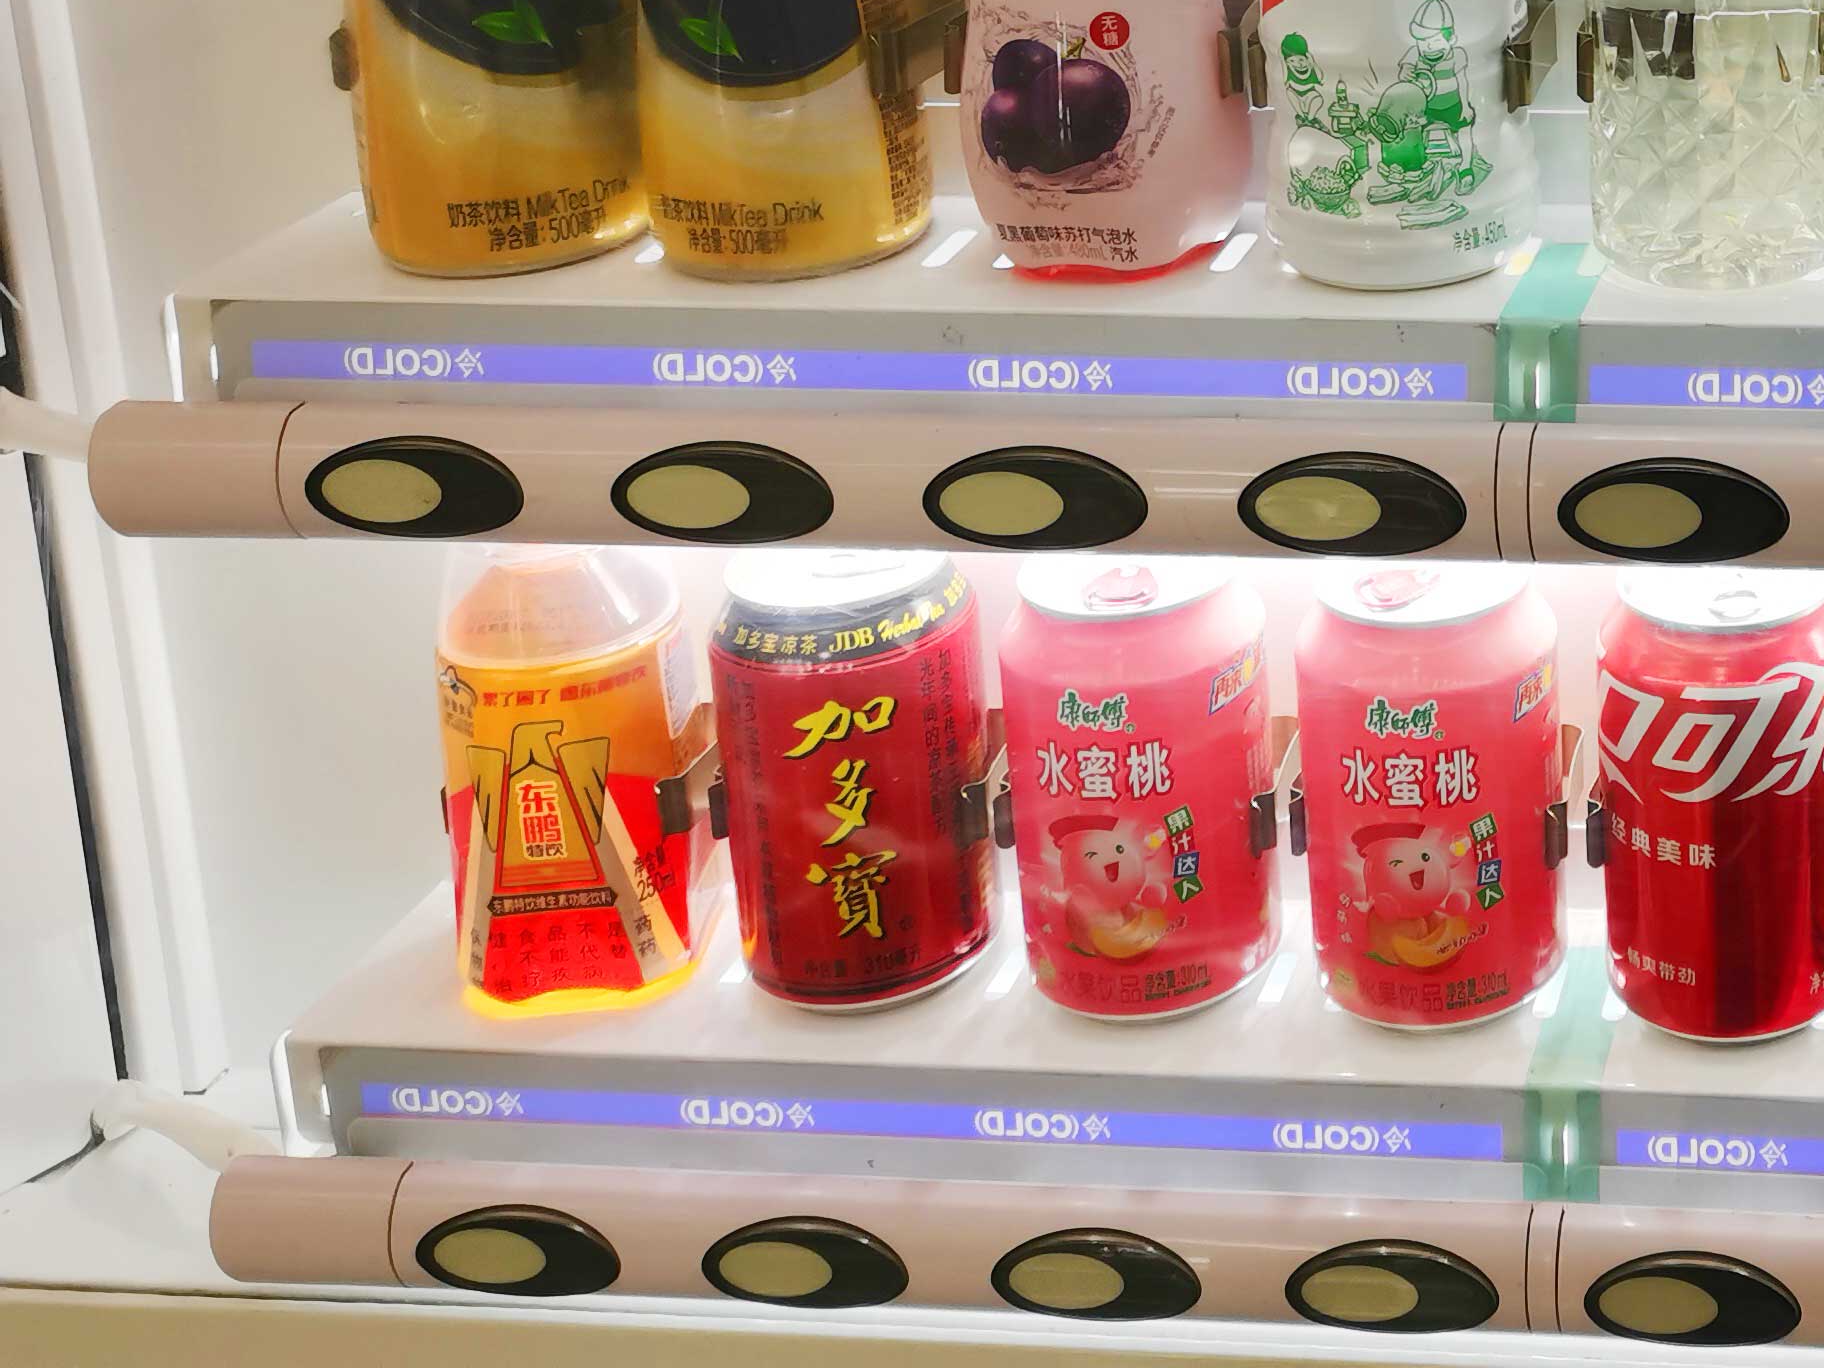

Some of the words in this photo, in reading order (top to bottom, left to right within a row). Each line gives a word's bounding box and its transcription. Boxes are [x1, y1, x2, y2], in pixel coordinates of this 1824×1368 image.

[733, 623, 818, 655] 加多宝凉茶
[828, 626, 875, 654] JDB
[1036, 740, 1174, 802] 水蜜桃
[1341, 745, 1479, 808] 水蜜桃
[517, 781, 563, 844] 东鹏
[1610, 812, 1717, 871] 经典美味
[525, 842, 565, 858] 特饮
[1165, 807, 1203, 902] 果汁达人
[1470, 815, 1504, 910] 果汁达人
[1627, 944, 1697, 987] 畅爽带劲
